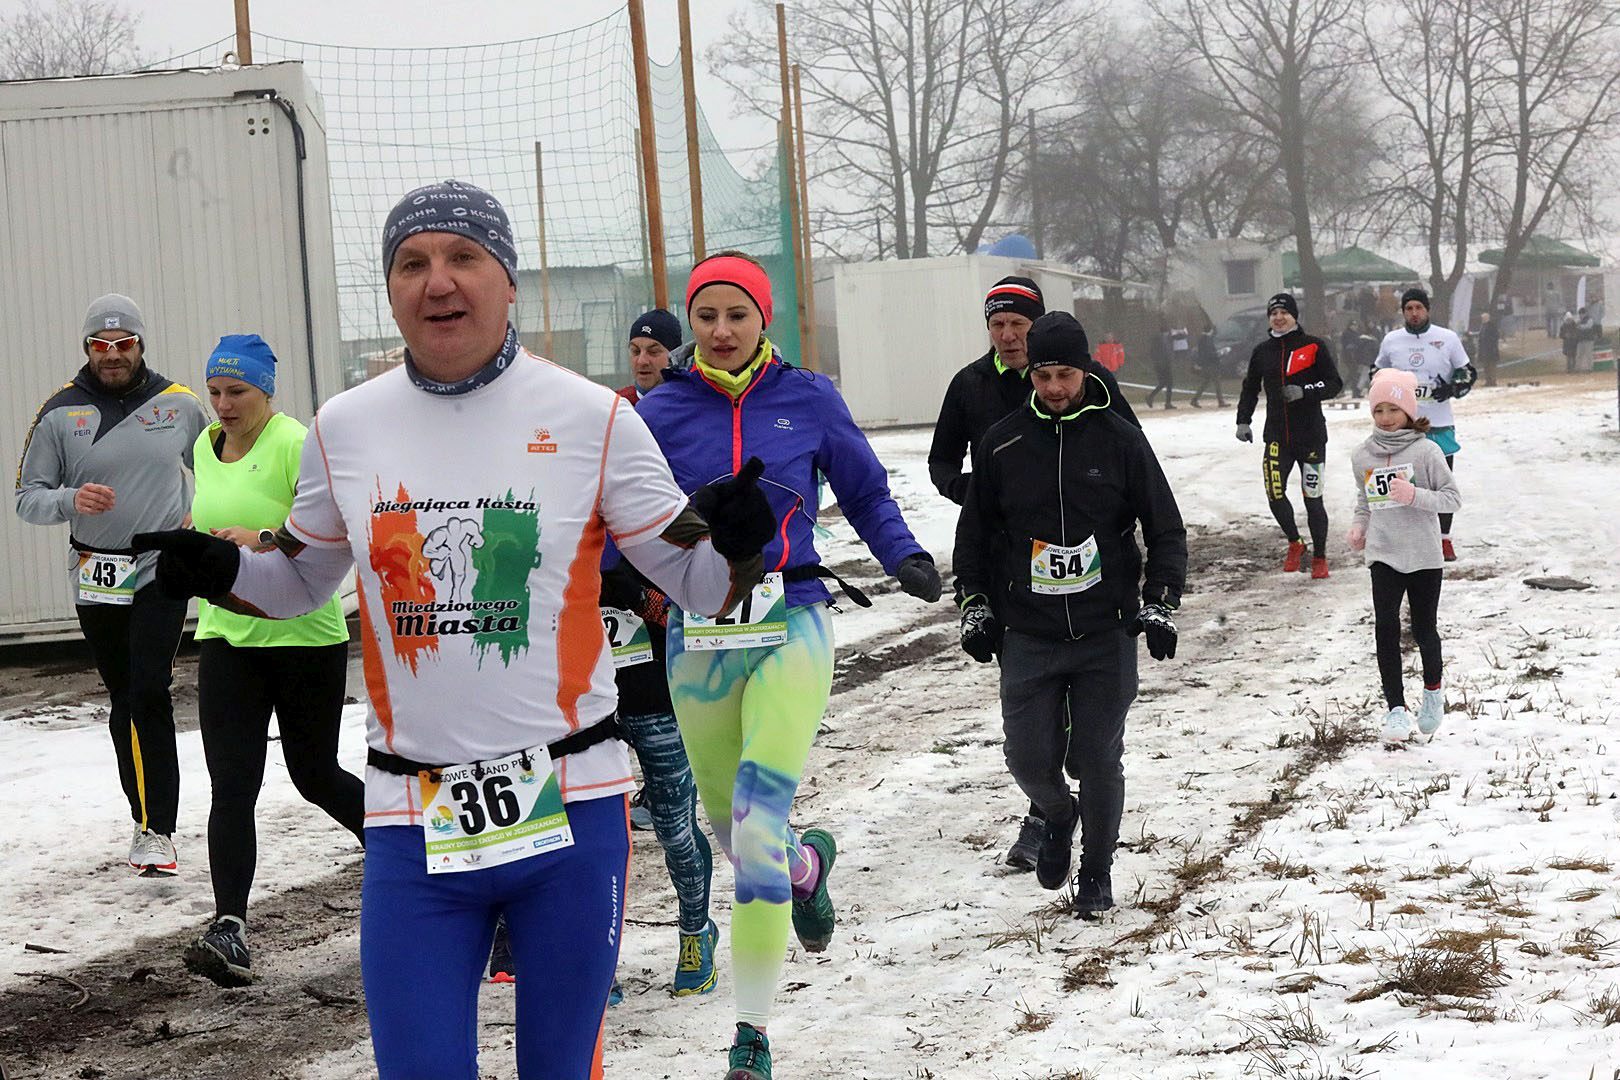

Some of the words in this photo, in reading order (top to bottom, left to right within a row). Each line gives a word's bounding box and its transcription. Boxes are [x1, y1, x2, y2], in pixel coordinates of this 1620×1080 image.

[429, 193, 470, 201] KGHM
[398, 206, 438, 227] KGHM
[470, 209, 502, 225] KGHM
[426, 220, 470, 230] KGHM
[1415, 385, 1428, 398] 57
[1305, 473, 1319, 489] 49
[373, 498, 471, 514] Biegająca
[476, 498, 536, 511] Kasta
[1061, 547, 1082, 555] GRAND
[92, 561, 117, 588] 43
[1050, 553, 1084, 580] 54
[392, 600, 519, 614] Miedziowego
[601, 609, 620, 617] RAND
[396, 614, 522, 637] Miasta
[451, 775, 521, 836] 36
